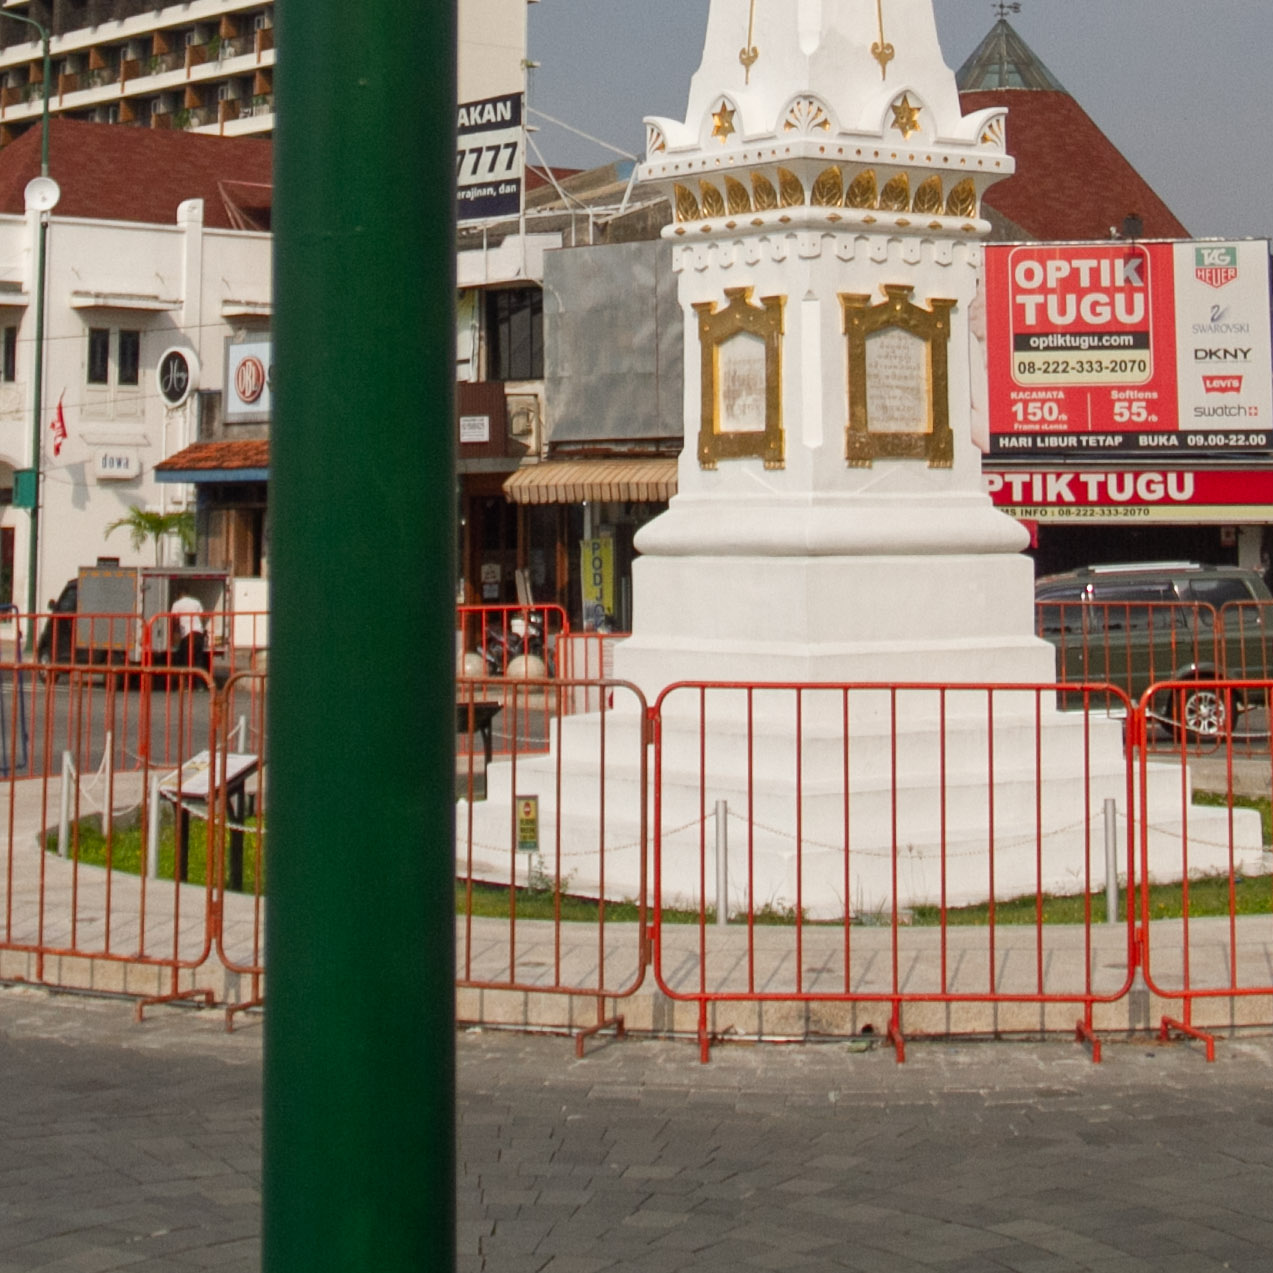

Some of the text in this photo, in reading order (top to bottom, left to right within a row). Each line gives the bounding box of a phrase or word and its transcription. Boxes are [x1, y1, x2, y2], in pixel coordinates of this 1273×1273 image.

[498, 183, 517, 195] dan
[1200, 248, 1231, 265] TAG
[1015, 257, 1145, 290] OPTIK
[1196, 268, 1237, 287] HEUER
[1015, 292, 1146, 326] TUGU
[1191, 323, 1250, 335] SWAROVSKI
[1029, 334, 1134, 349] optiktugu.com
[1193, 348, 1253, 360] DKNY
[1017, 359, 1147, 375] 08-222-333-2070
[1010, 391, 1065, 400] KACAMATA
[1111, 390, 1158, 400] Softlens
[1193, 404, 1248, 417] swatch
[999, 434, 1267, 448] HARI LIBUR TETAP BUKA 09.00-22.00
[102, 453, 129, 470] dowa
[1079, 472, 1195, 502] TUGU
[1020, 508, 1047, 517] INFO
[1057, 507, 1150, 516] 08-222-333-2070
